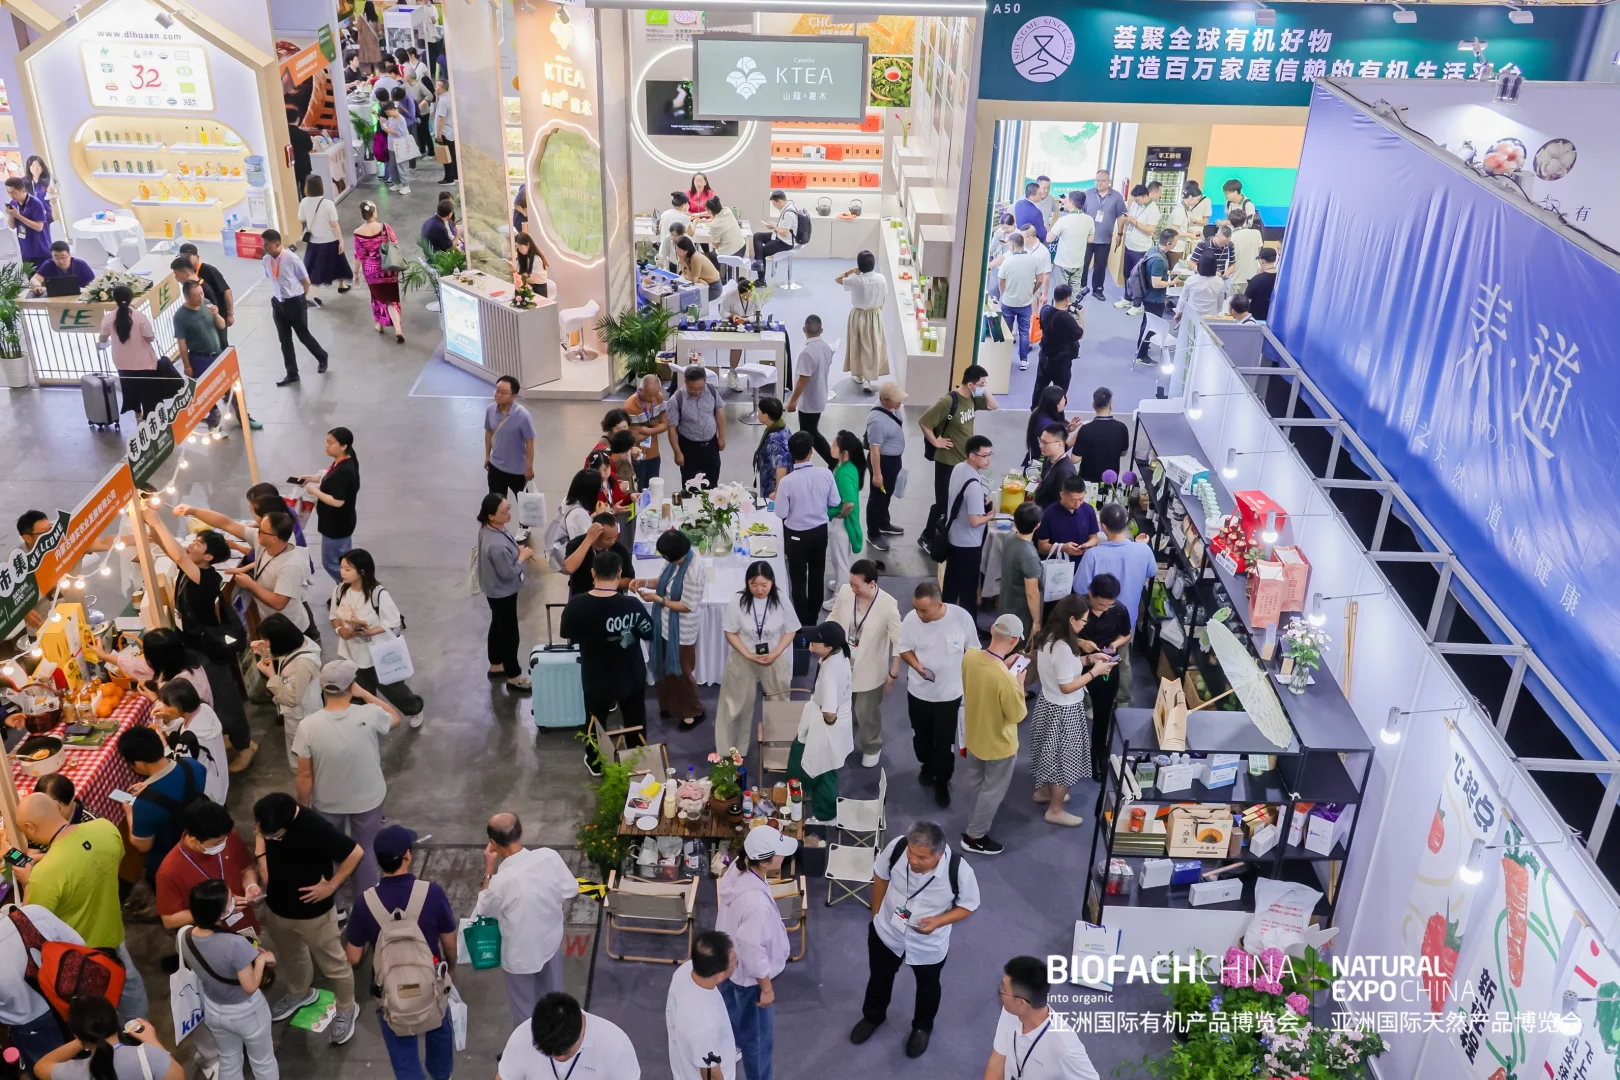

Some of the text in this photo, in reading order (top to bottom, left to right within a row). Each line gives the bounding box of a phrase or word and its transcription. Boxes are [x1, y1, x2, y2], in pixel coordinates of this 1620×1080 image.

[993, 3, 1021, 14] A50
[97, 30, 182, 41] www.dlhuaen.com
[1043, 19, 1067, 33] SINCE
[1113, 25, 1333, 53] 荟聚全球有机好物
[129, 64, 162, 90] 32
[544, 61, 586, 90] KTEA
[776, 66, 834, 85] KTEA
[1574, 205, 1592, 222] 有
[168, 387, 193, 420] WELCOME
[129, 405, 168, 457] 有机市集
[29, 522, 65, 568] WELCOME
